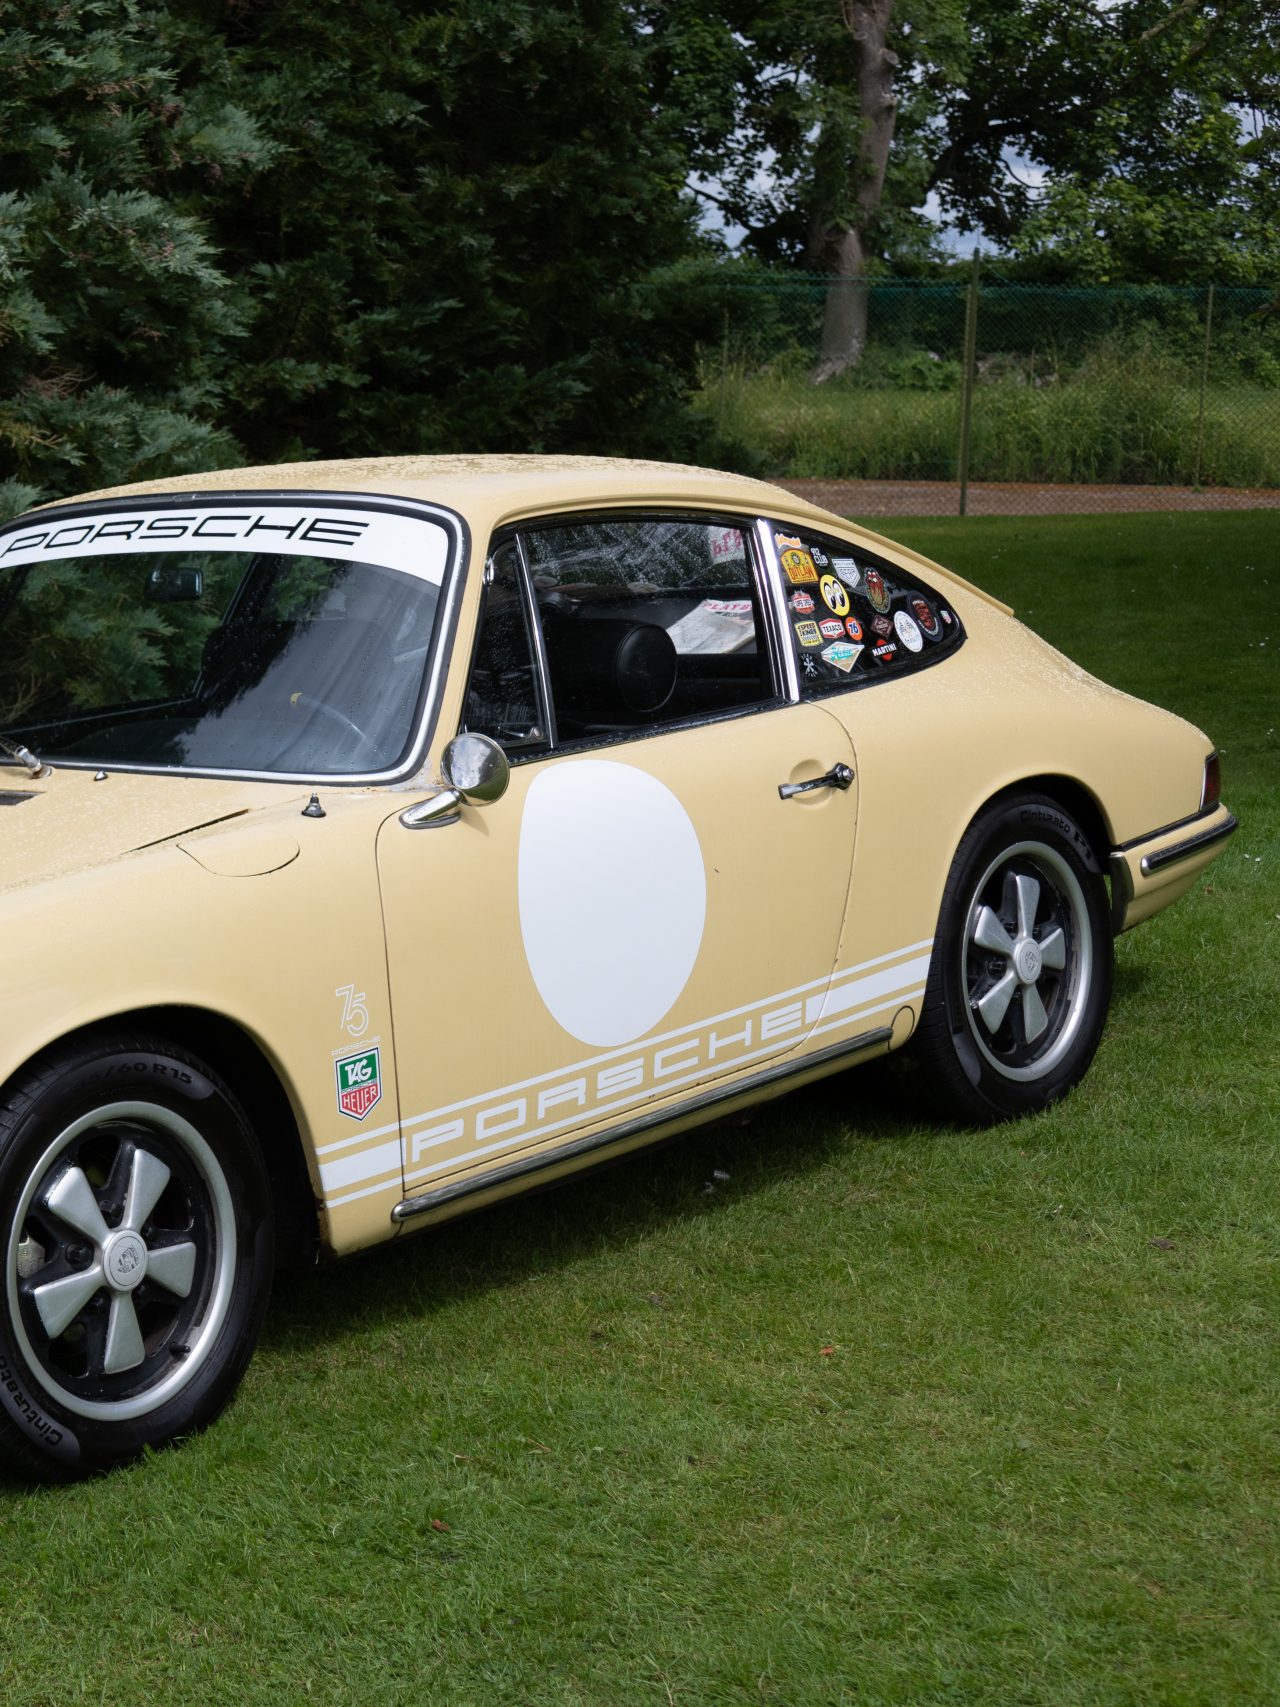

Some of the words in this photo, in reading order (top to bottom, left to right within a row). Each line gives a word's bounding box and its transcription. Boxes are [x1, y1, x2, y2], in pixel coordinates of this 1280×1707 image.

[0, 515, 370, 559] PORSCHE
[789, 565, 815, 580] OUTLAW
[800, 622, 815, 631] SPEED
[823, 624, 842, 633] TEXACO
[849, 623, 859, 633] 76
[872, 642, 897, 657] MARTINI
[1021, 811, 1071, 833] Cinturato
[335, 983, 369, 1037] 75
[153, 1063, 192, 1085] R15
[344, 1059, 372, 1086] TAG
[411, 1001, 803, 1163] PORSCHE
[342, 1085, 377, 1113] HEUER
